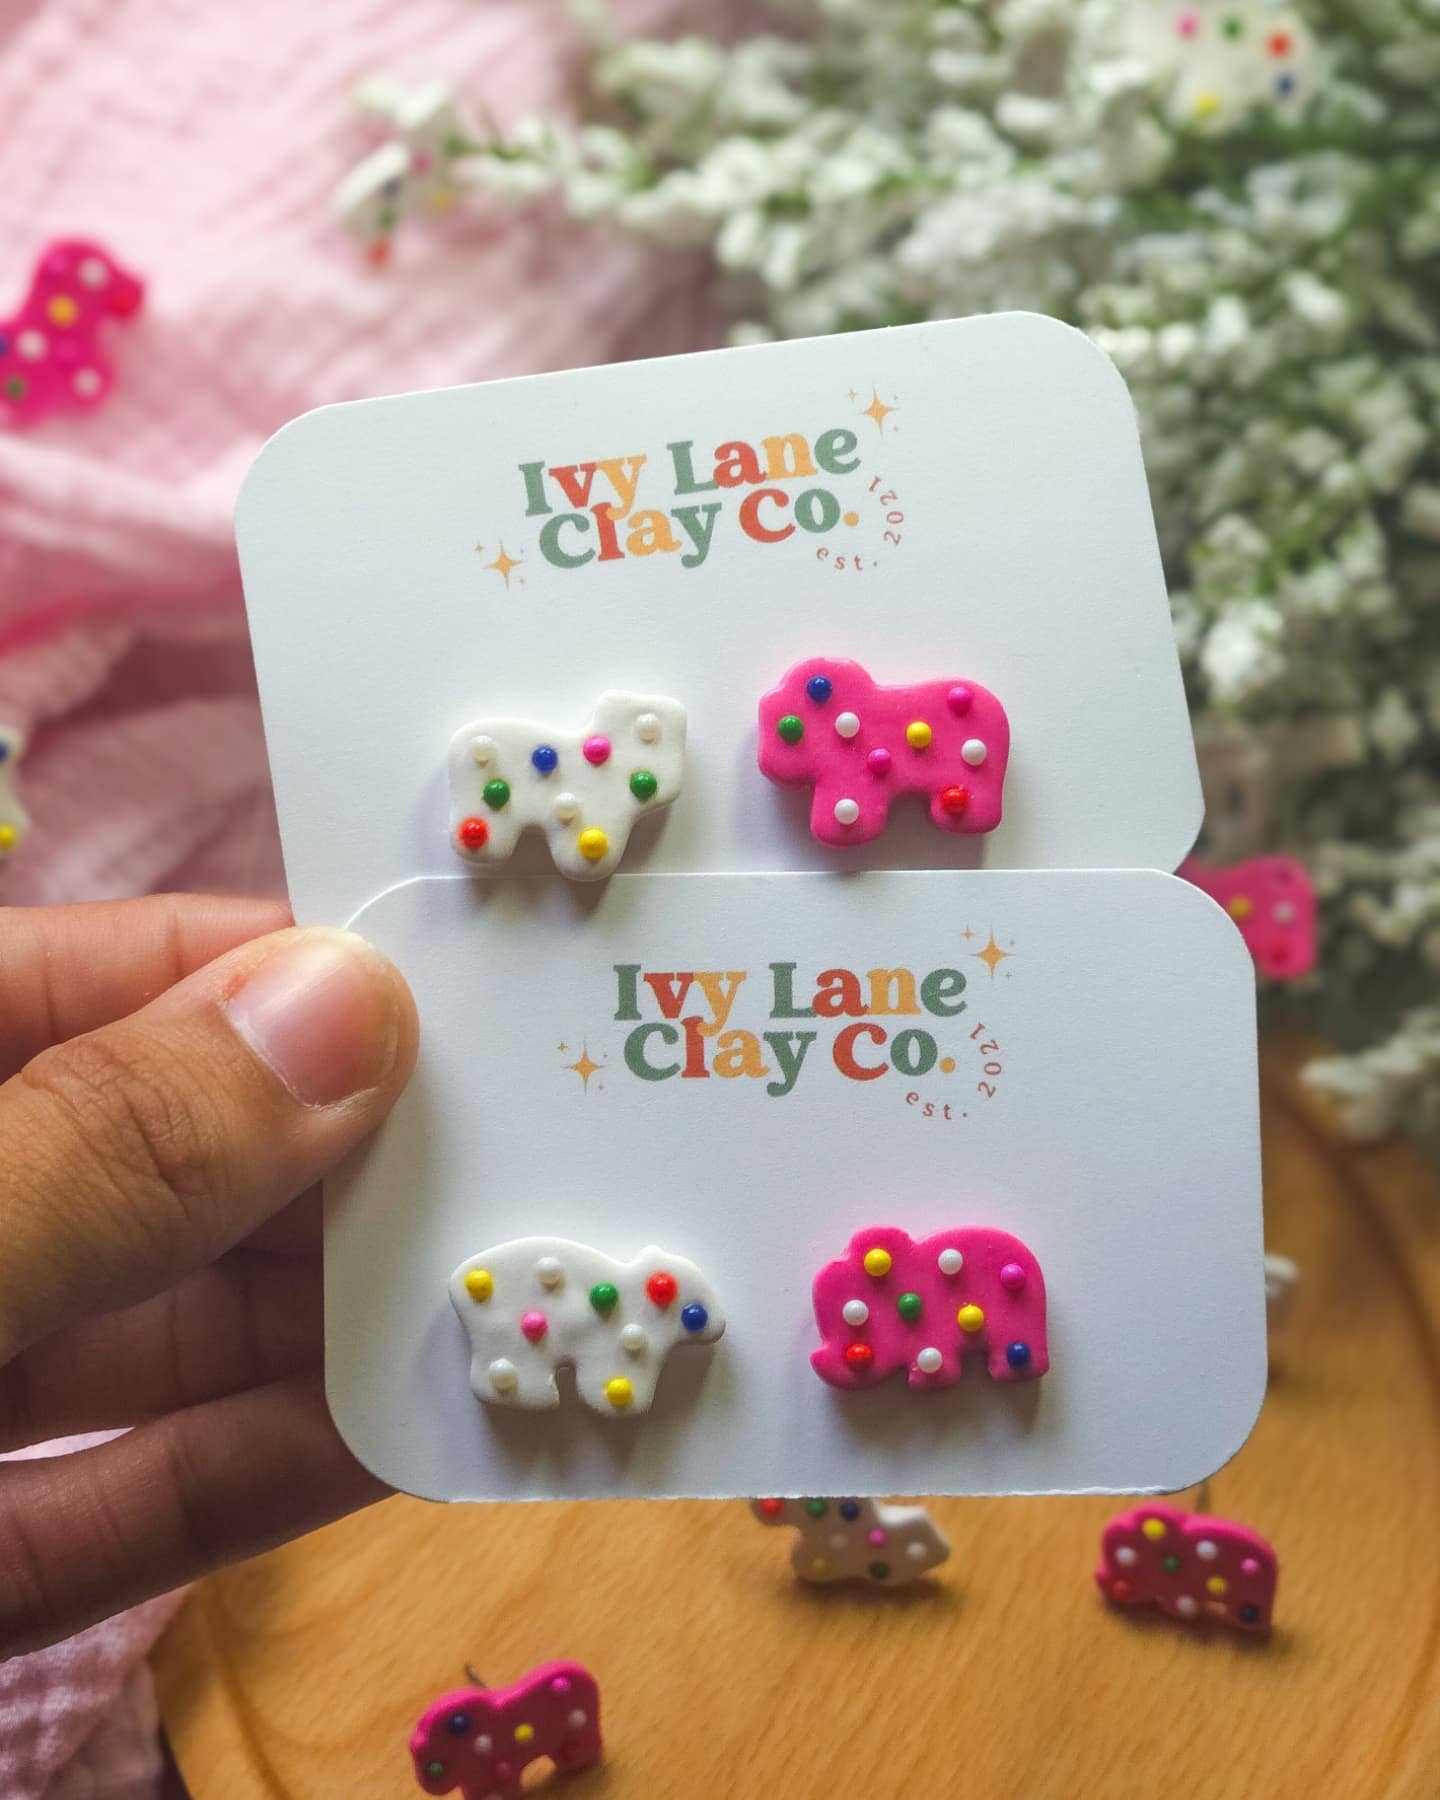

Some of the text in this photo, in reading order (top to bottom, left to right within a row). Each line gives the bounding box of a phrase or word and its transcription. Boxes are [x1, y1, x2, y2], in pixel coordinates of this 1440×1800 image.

[518, 428, 862, 520] Ivy Lane
[538, 487, 860, 569] Clay Co.
[816, 475, 905, 572] est. 2021
[613, 961, 968, 1036] Ivy Lane
[623, 1016, 956, 1098] Clay Co.
[905, 1022, 1002, 1121] est. 2021
